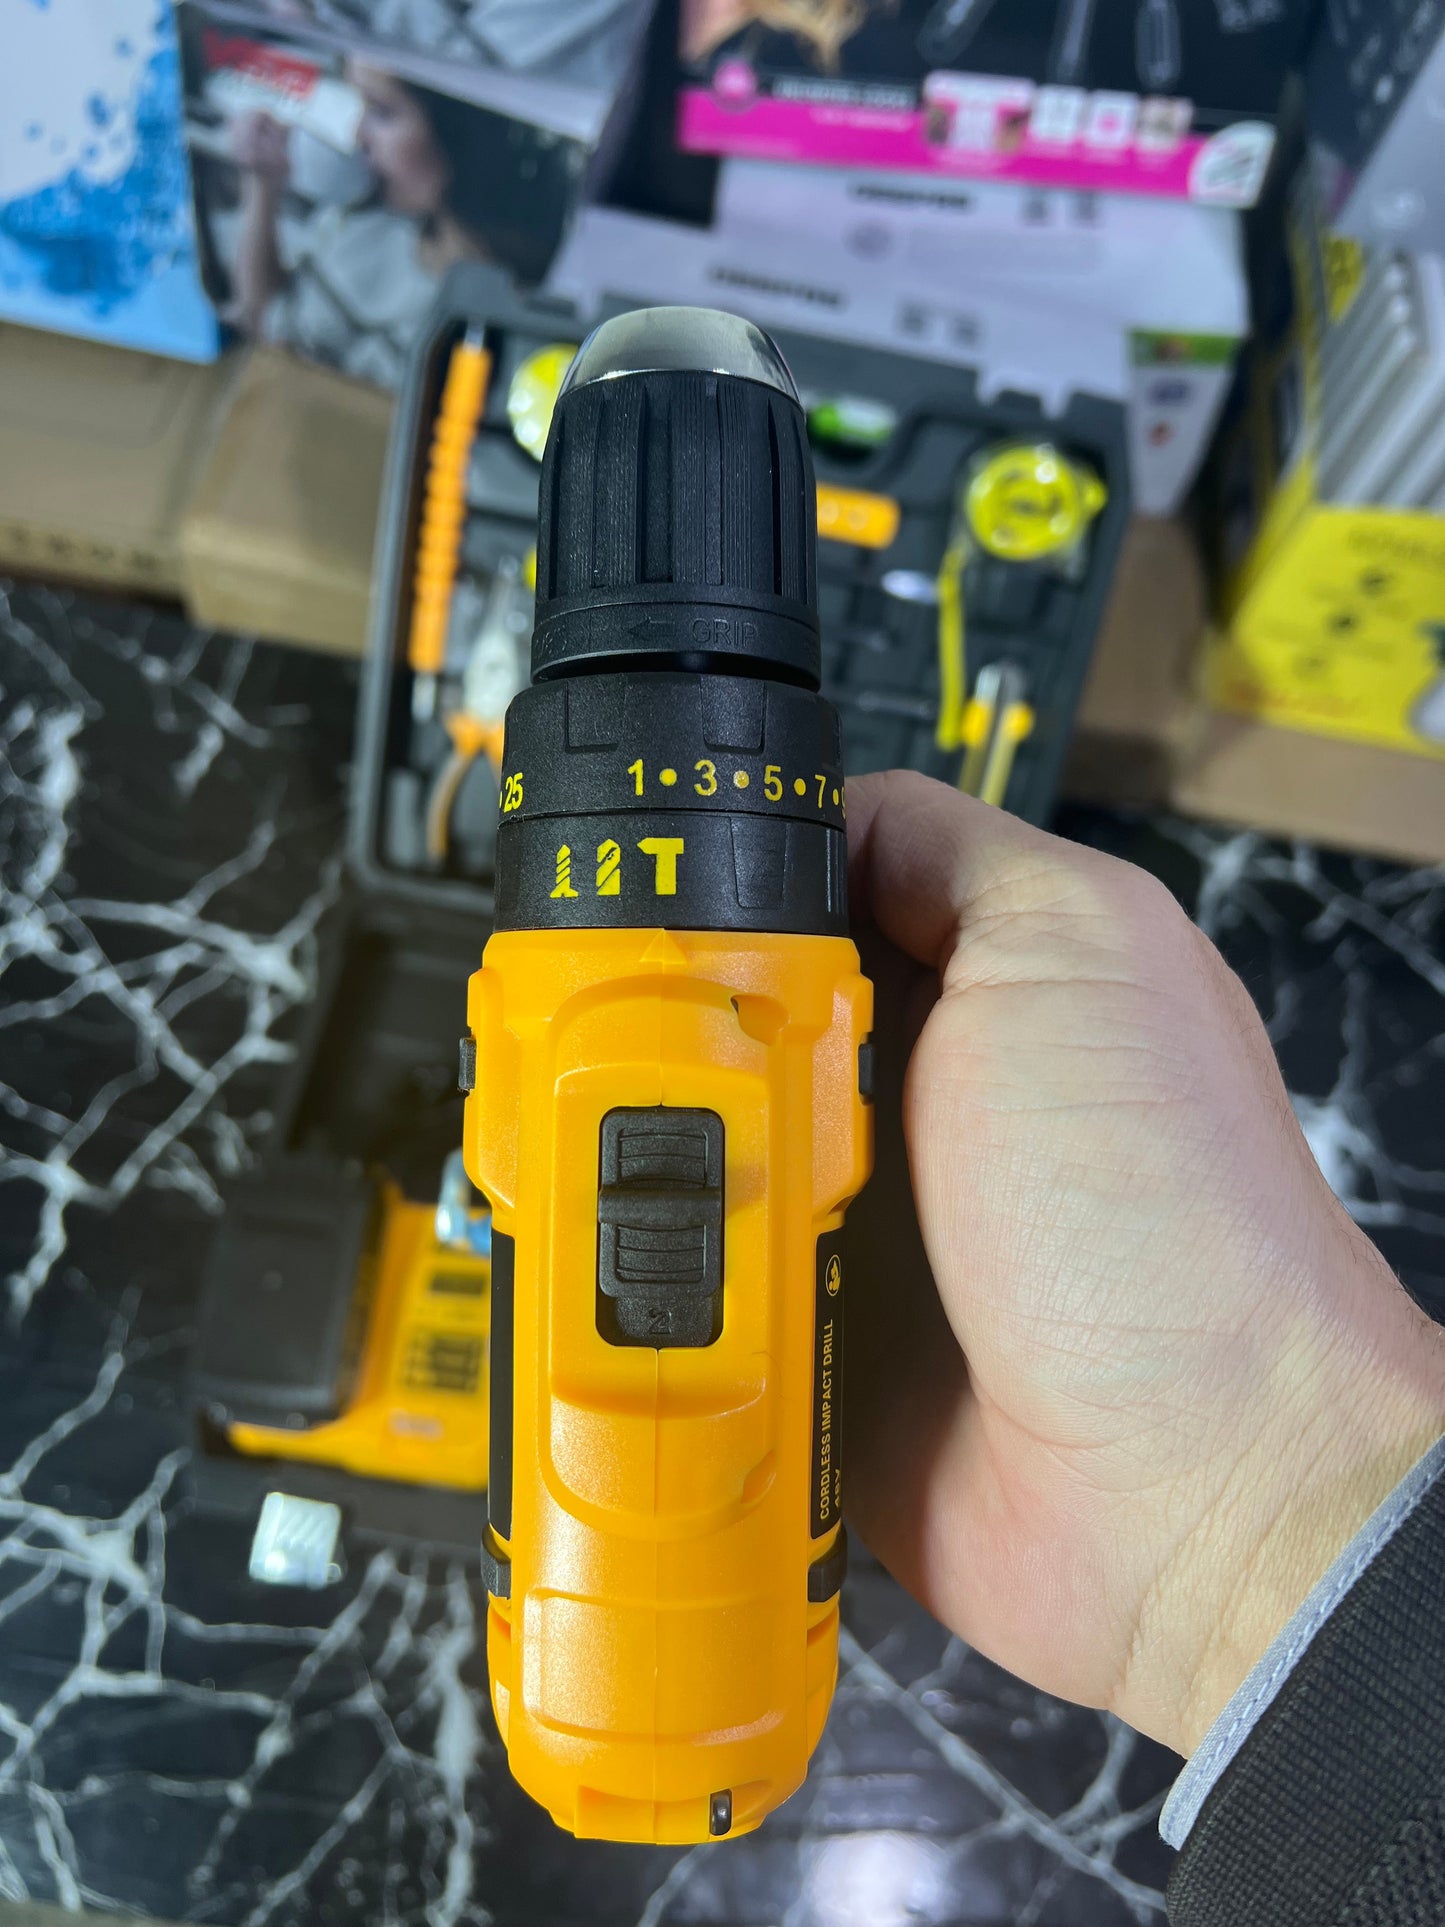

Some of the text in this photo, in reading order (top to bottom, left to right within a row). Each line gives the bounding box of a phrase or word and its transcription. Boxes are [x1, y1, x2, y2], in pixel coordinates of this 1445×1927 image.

[691, 617, 758, 647] GRIP
[503, 772, 524, 813] 25
[627, 759, 644, 797] 1
[694, 759, 717, 797] 3
[764, 765, 783, 802] 5
[814, 774, 827, 809] 7
[820, 1319, 833, 1520] CORDLESS IMPACT DRILL
